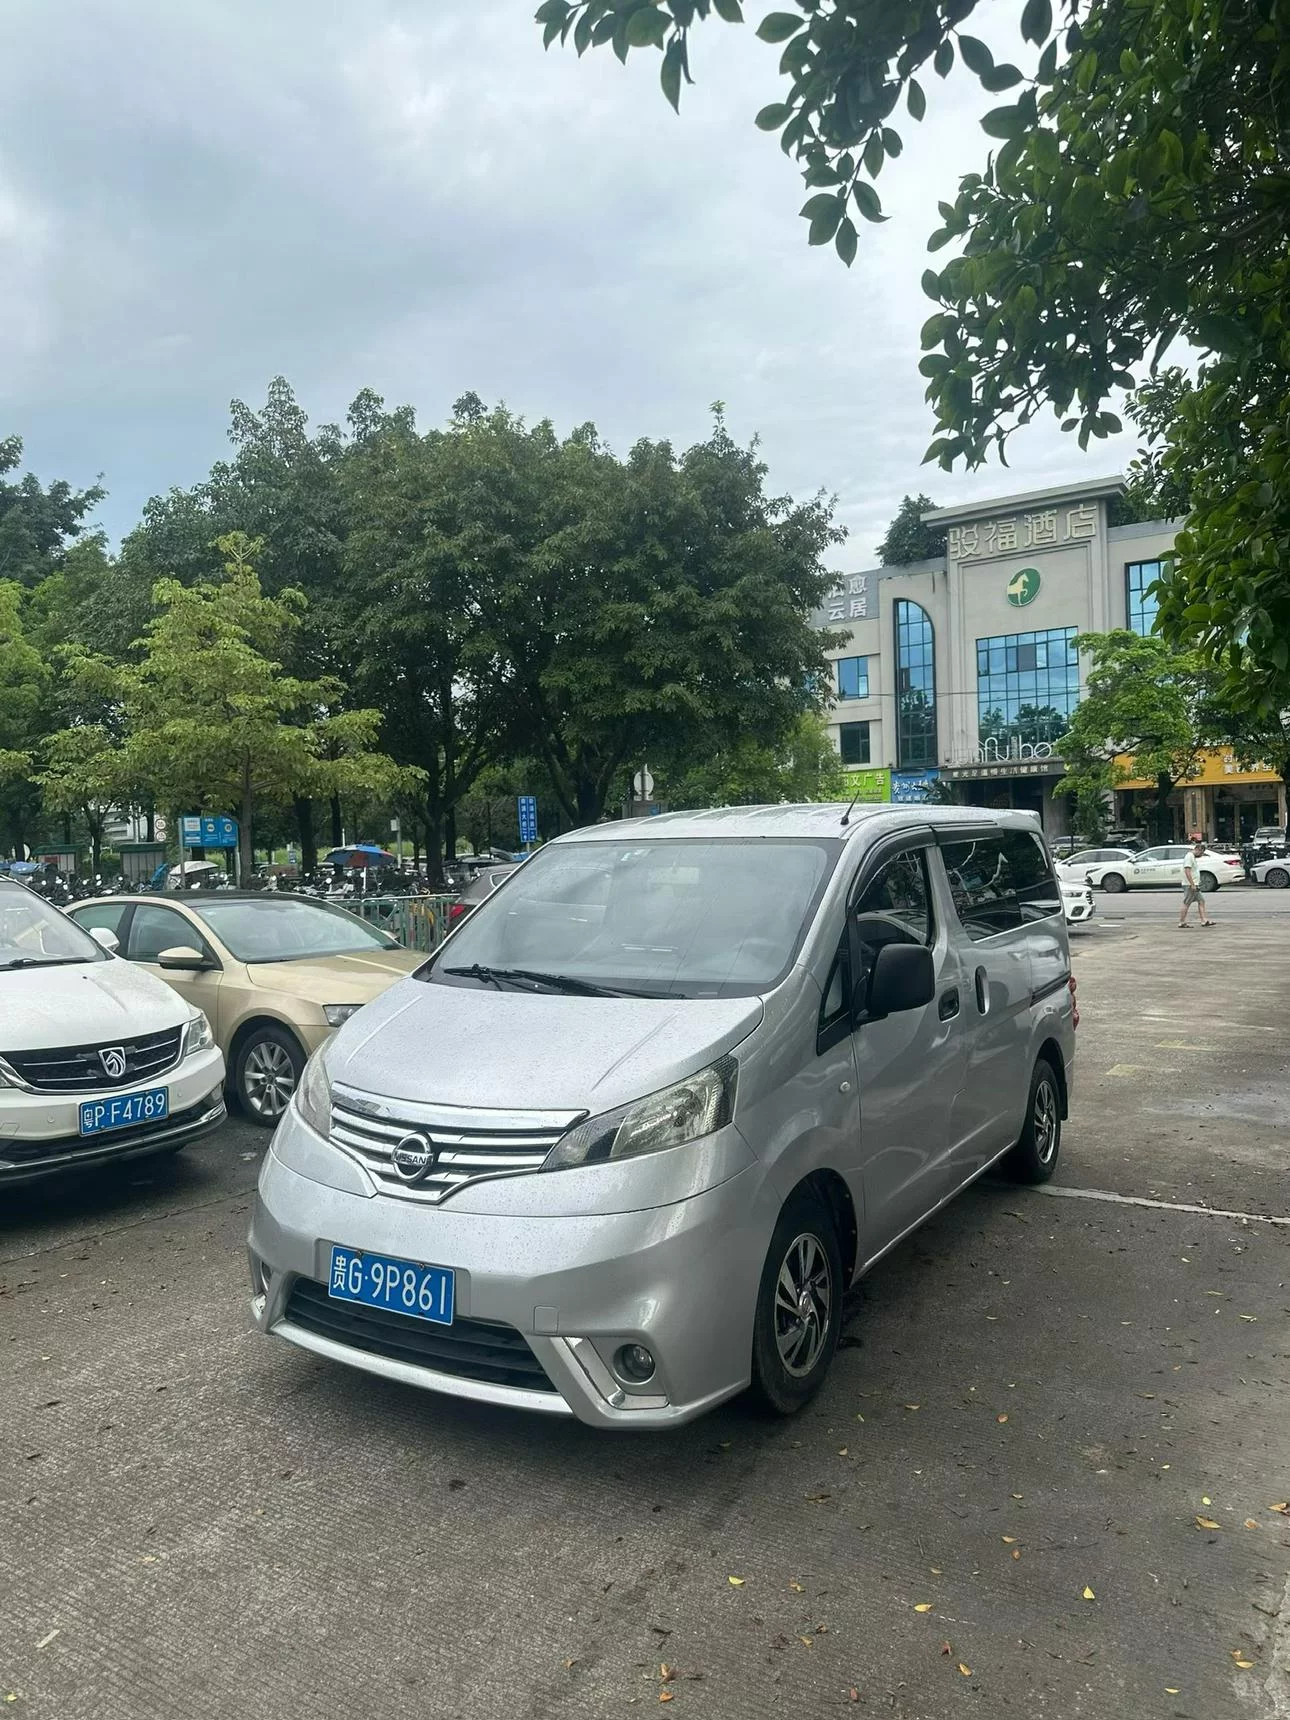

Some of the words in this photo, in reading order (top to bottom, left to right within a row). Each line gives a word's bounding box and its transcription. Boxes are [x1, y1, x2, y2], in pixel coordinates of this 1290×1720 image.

[949, 503, 1097, 560] 骏福酒店
[828, 597, 868, 621] 云居
[395, 1150, 428, 1165] NISSAN
[333, 1254, 446, 1315] 贵G·9P861
